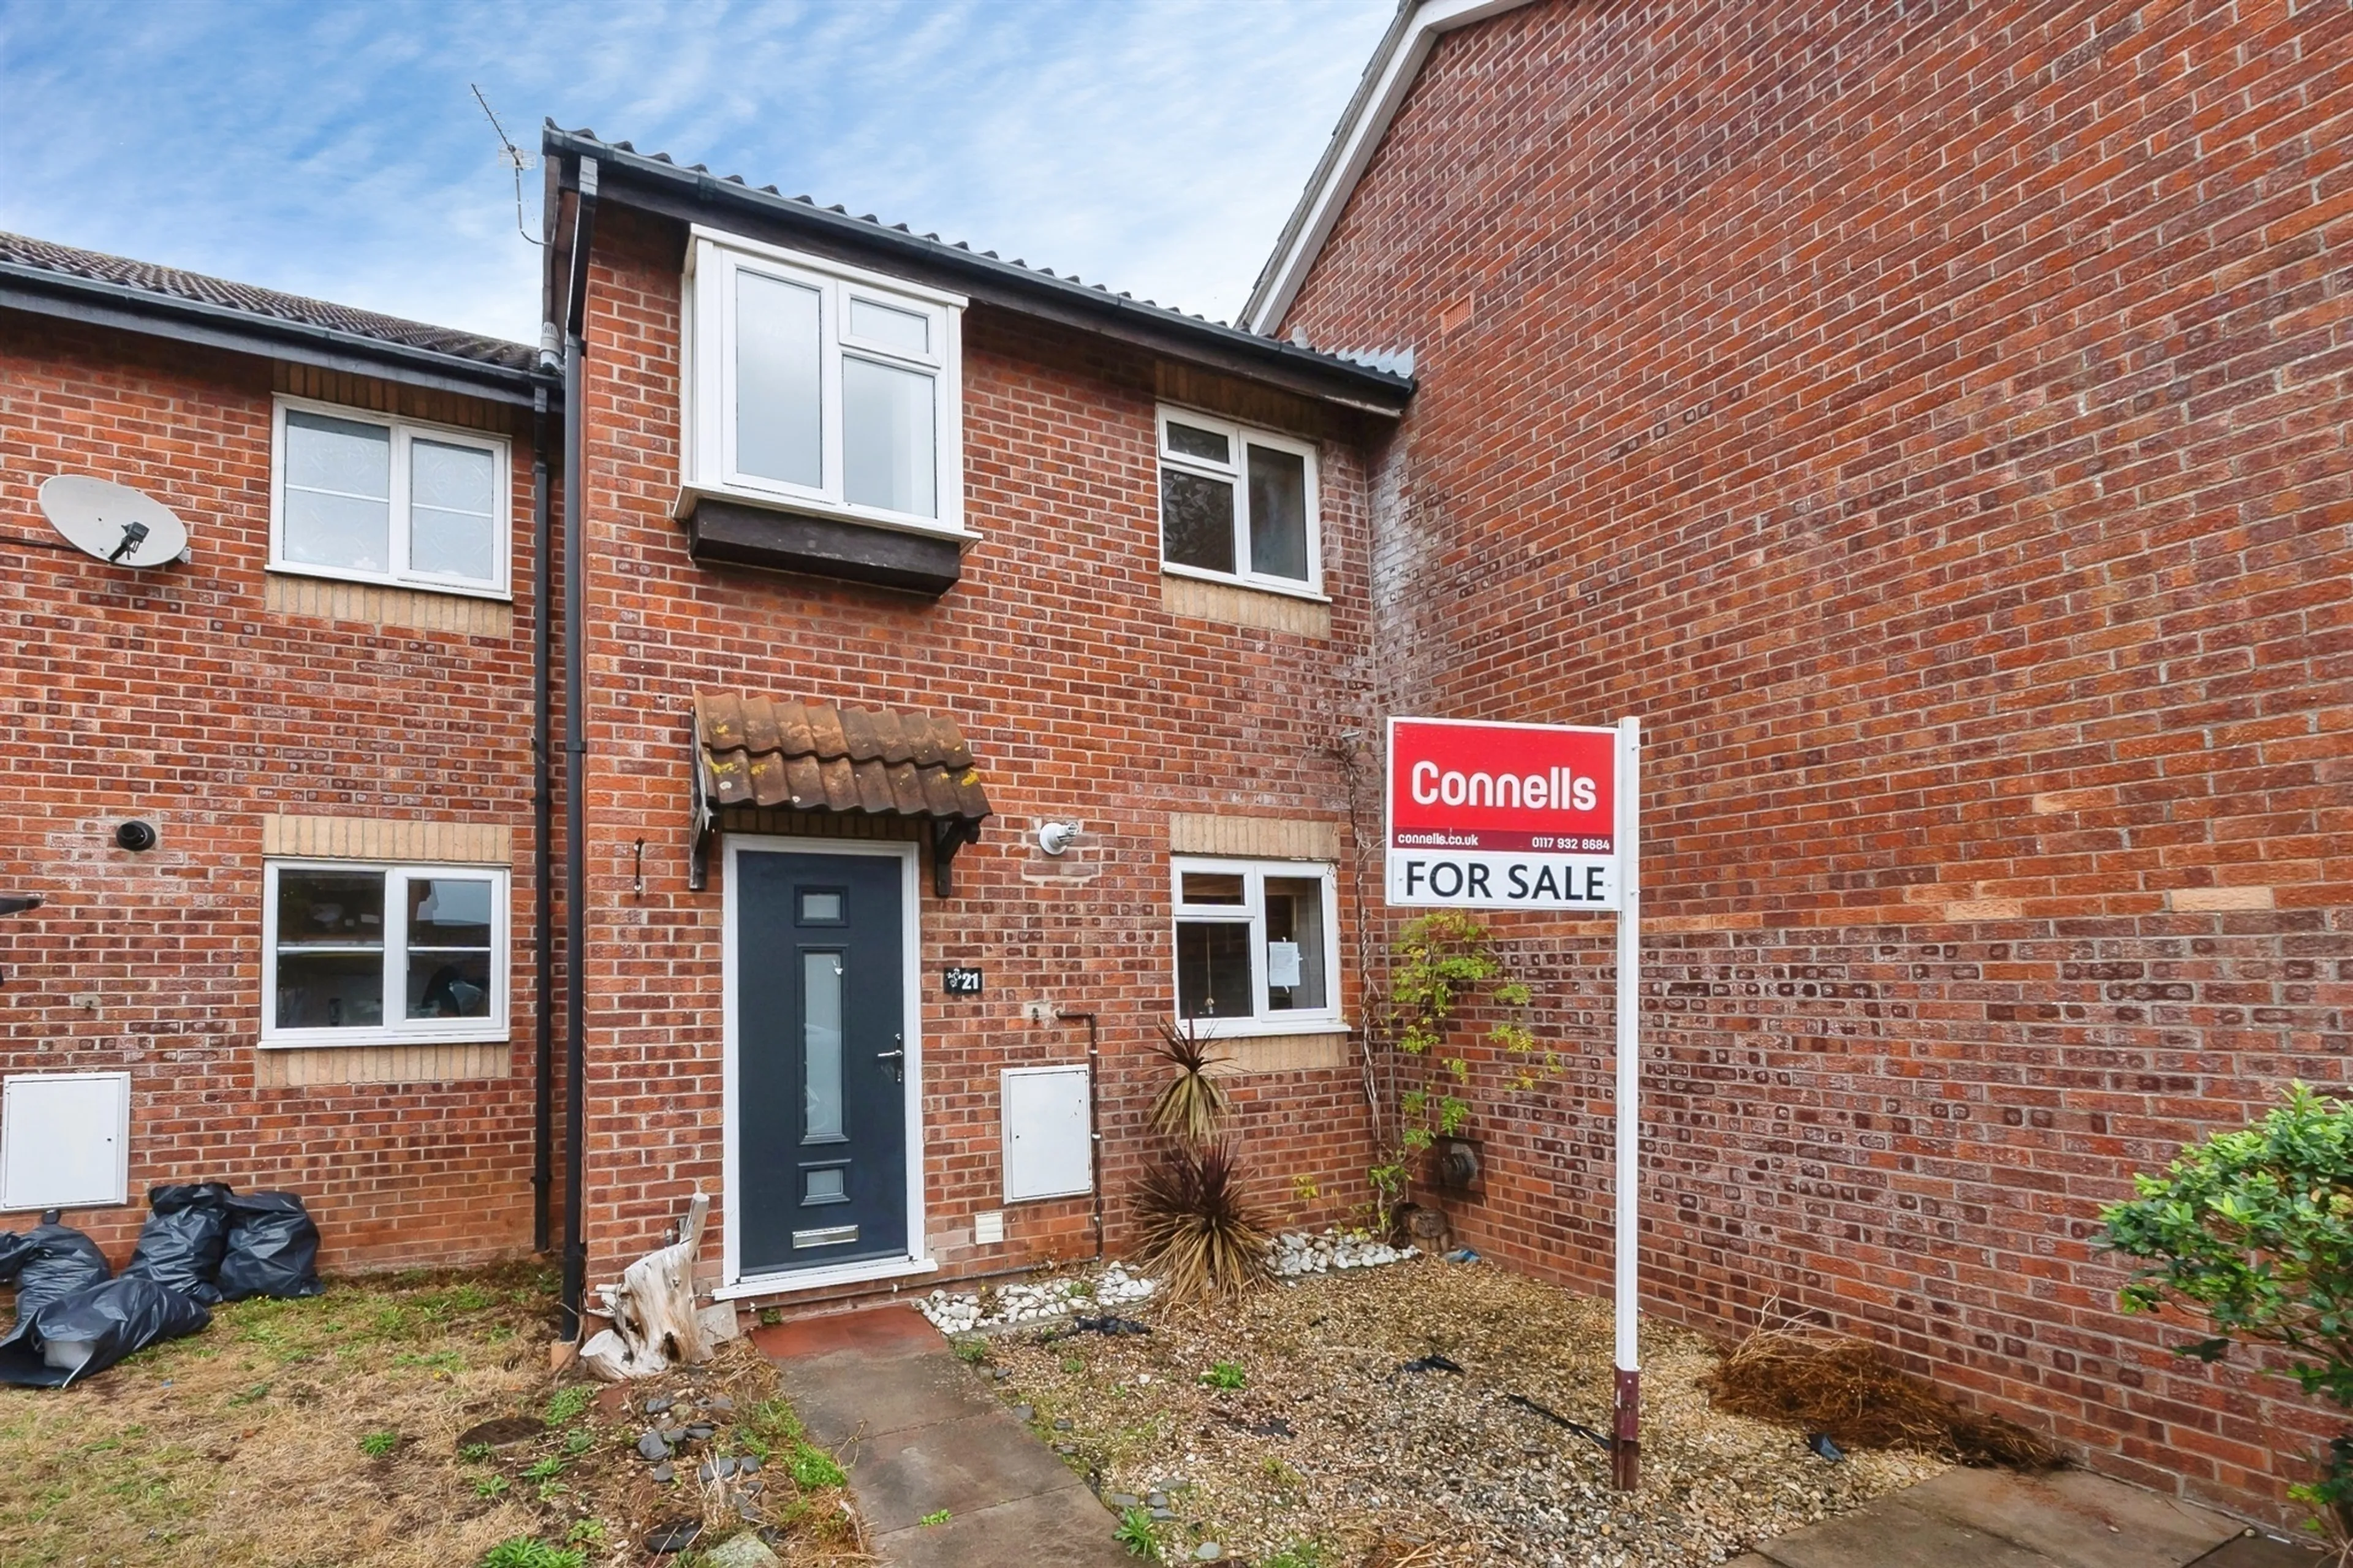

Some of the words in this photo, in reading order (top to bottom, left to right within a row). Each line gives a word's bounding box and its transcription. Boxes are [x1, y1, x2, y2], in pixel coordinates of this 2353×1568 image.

[1412, 760, 1597, 811] Connells
[1398, 833, 1479, 846] connells.co.uk
[1532, 836, 1555, 848] 0117
[1557, 838, 1578, 849] 932
[1582, 838, 1610, 850] 8684
[1406, 861, 1493, 898] FOR
[1507, 864, 1605, 901] SALE
[961, 972, 979, 990] 21
